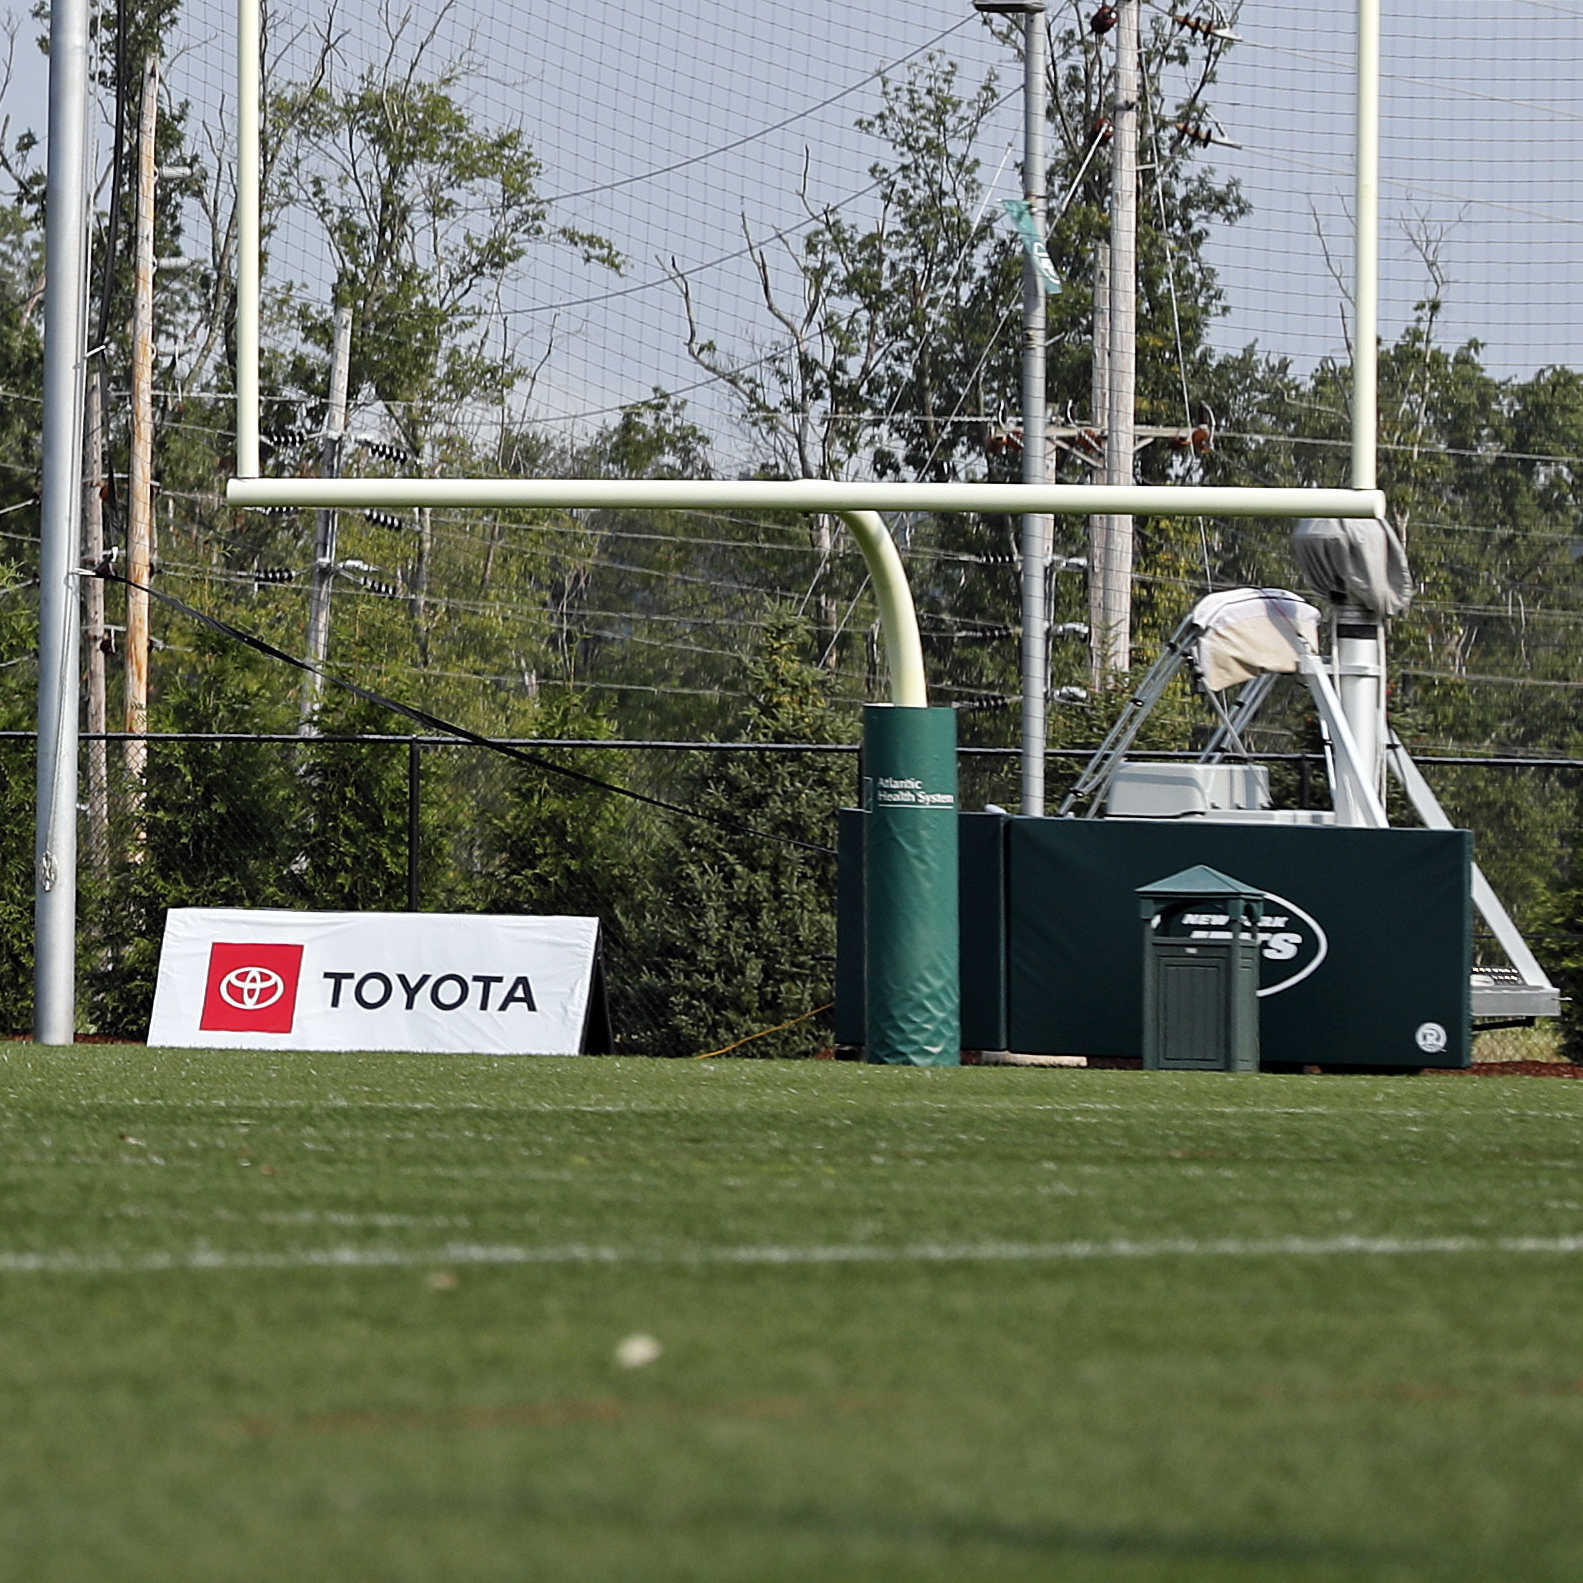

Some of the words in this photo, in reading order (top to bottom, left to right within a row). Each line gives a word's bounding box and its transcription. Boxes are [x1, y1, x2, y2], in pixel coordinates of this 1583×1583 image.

[878, 777, 923, 790] Atlantic
[877, 790, 916, 803] Health
[1181, 914, 1230, 925] NEW
[323, 971, 538, 1012] TOYOTA
